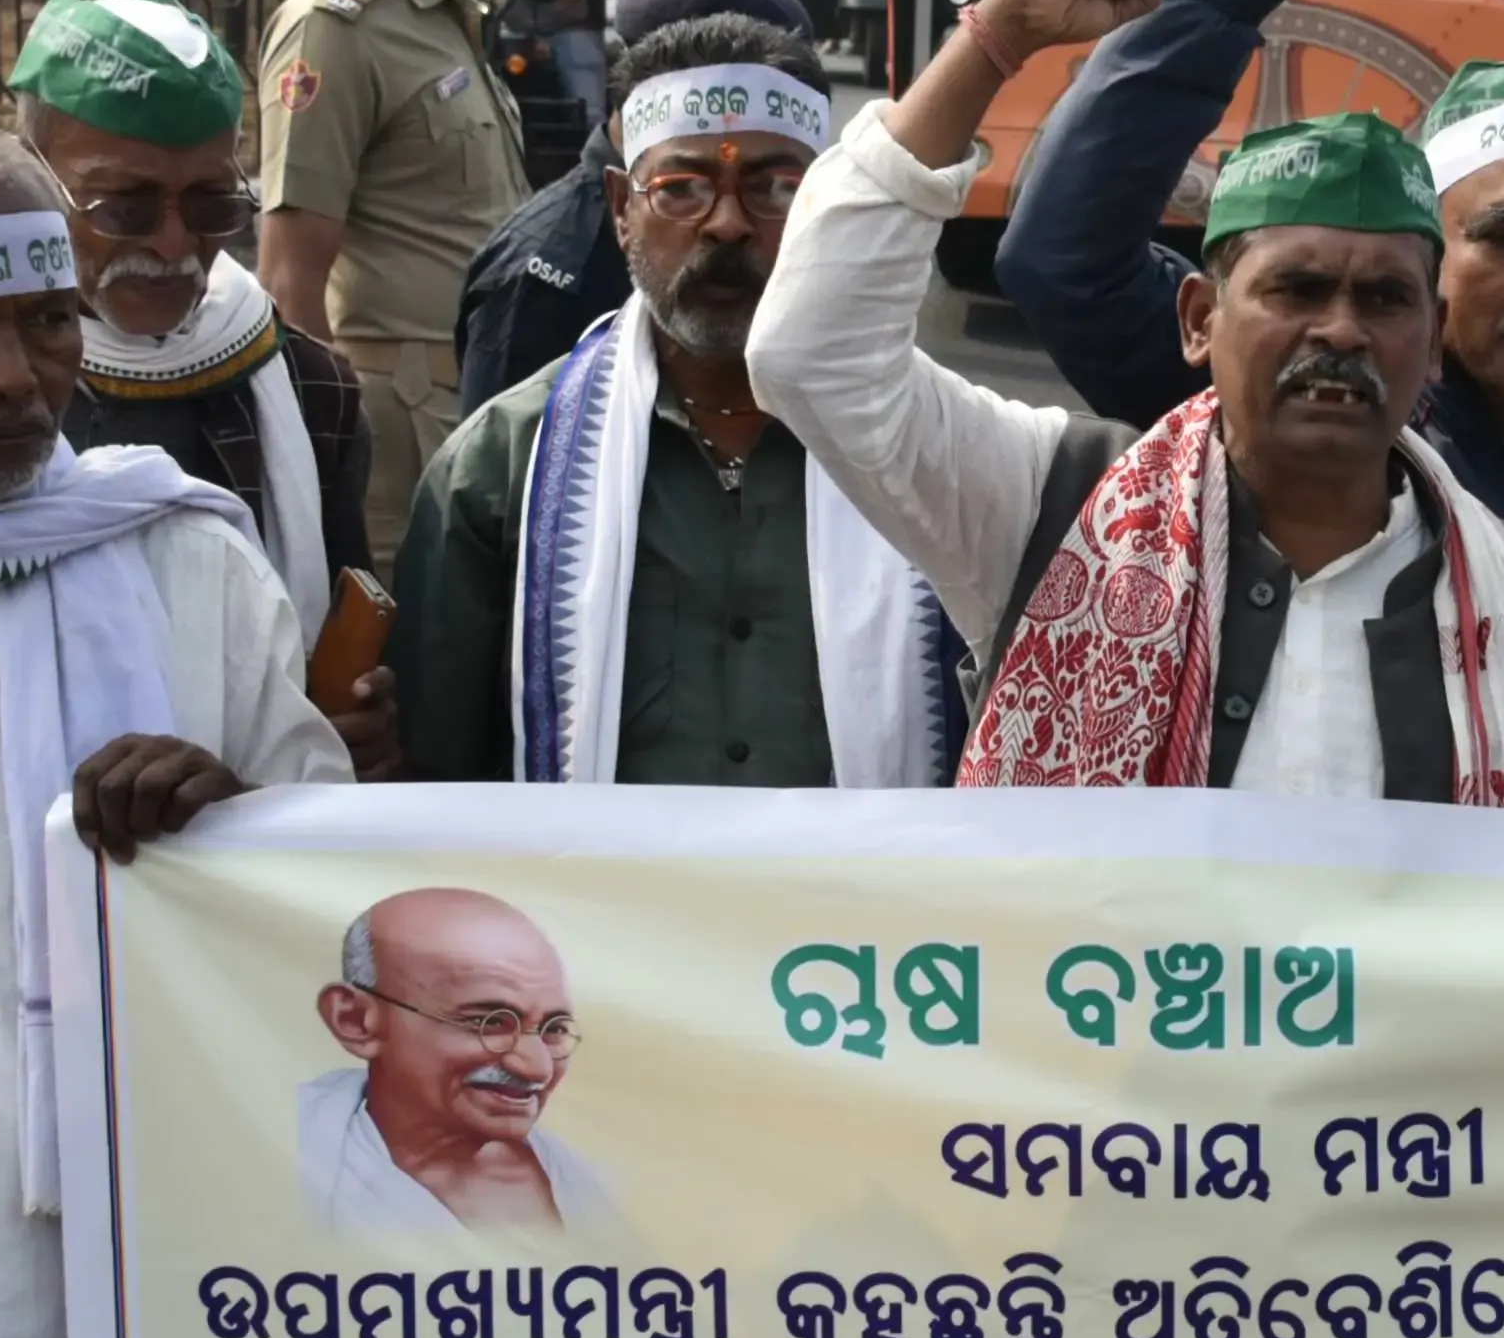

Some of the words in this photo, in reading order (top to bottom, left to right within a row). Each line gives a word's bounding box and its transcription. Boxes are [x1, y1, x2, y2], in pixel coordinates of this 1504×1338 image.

[682, 85, 750, 130] କୃଷକ
[940, 1119, 1271, 1202] ସମବାୟ
[1313, 1107, 1484, 1198] ମନ୍ତ୍ରୀ
